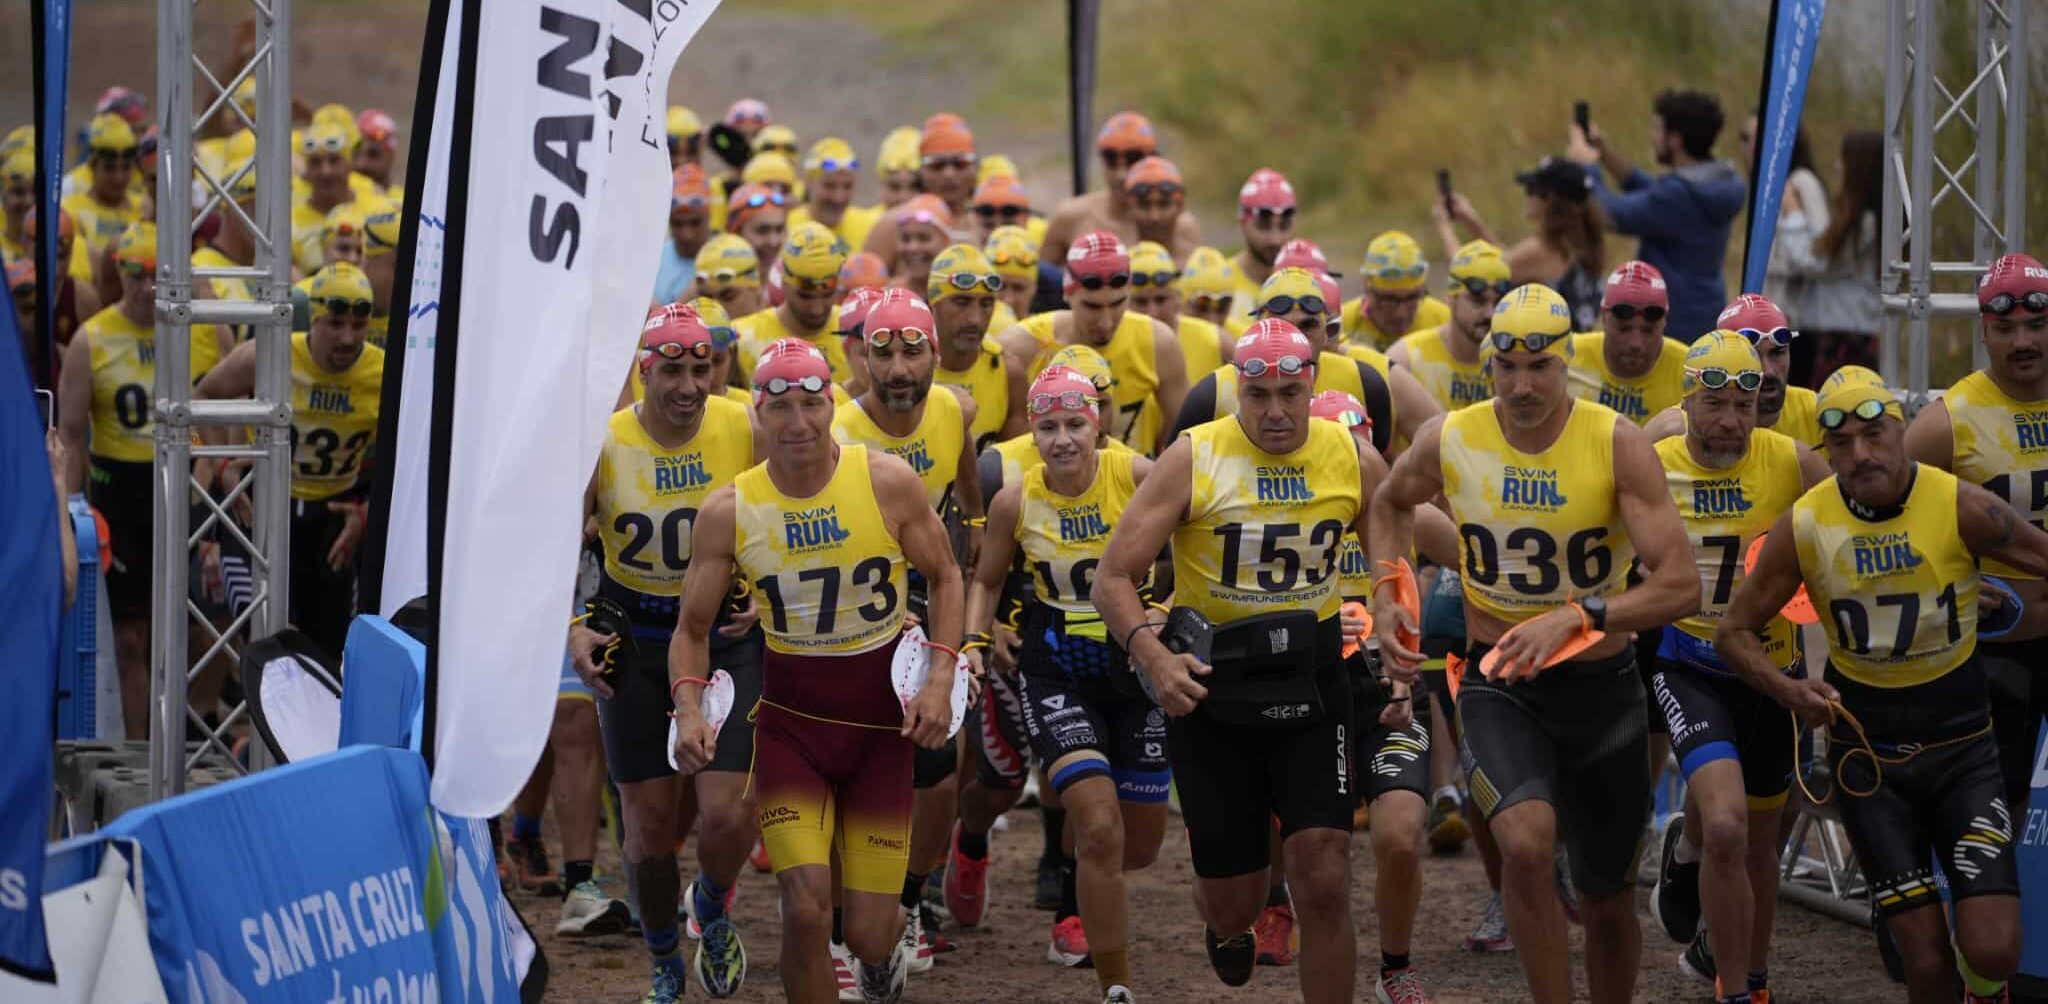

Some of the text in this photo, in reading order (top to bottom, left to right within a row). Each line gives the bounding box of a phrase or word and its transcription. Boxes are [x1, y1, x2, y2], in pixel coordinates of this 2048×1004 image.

[654, 452, 702, 466] SWIM
[1256, 466, 1304, 476] SWIM
[1504, 466, 1557, 479] SWIM
[656, 461, 712, 490] RUN
[1257, 476, 1314, 501] RUN
[1692, 477, 1741, 488] SWIM
[1502, 477, 1567, 507] RUN
[1694, 487, 1751, 514] RUN
[784, 504, 836, 522] SWIM
[1056, 503, 1100, 517] SWIM
[785, 515, 849, 550] RUN
[1060, 512, 1110, 541] RUN
[1852, 531, 1909, 548] SWIM
[1213, 518, 1344, 592] 153
[1459, 523, 1612, 596] 036
[1855, 542, 1921, 575] RUN
[755, 556, 898, 634] 173
[1829, 583, 1962, 657] 071
[1060, 735, 1098, 748] HILDO
[1336, 724, 1348, 795] HEAD
[240, 866, 425, 987] SANTA CRUZ
